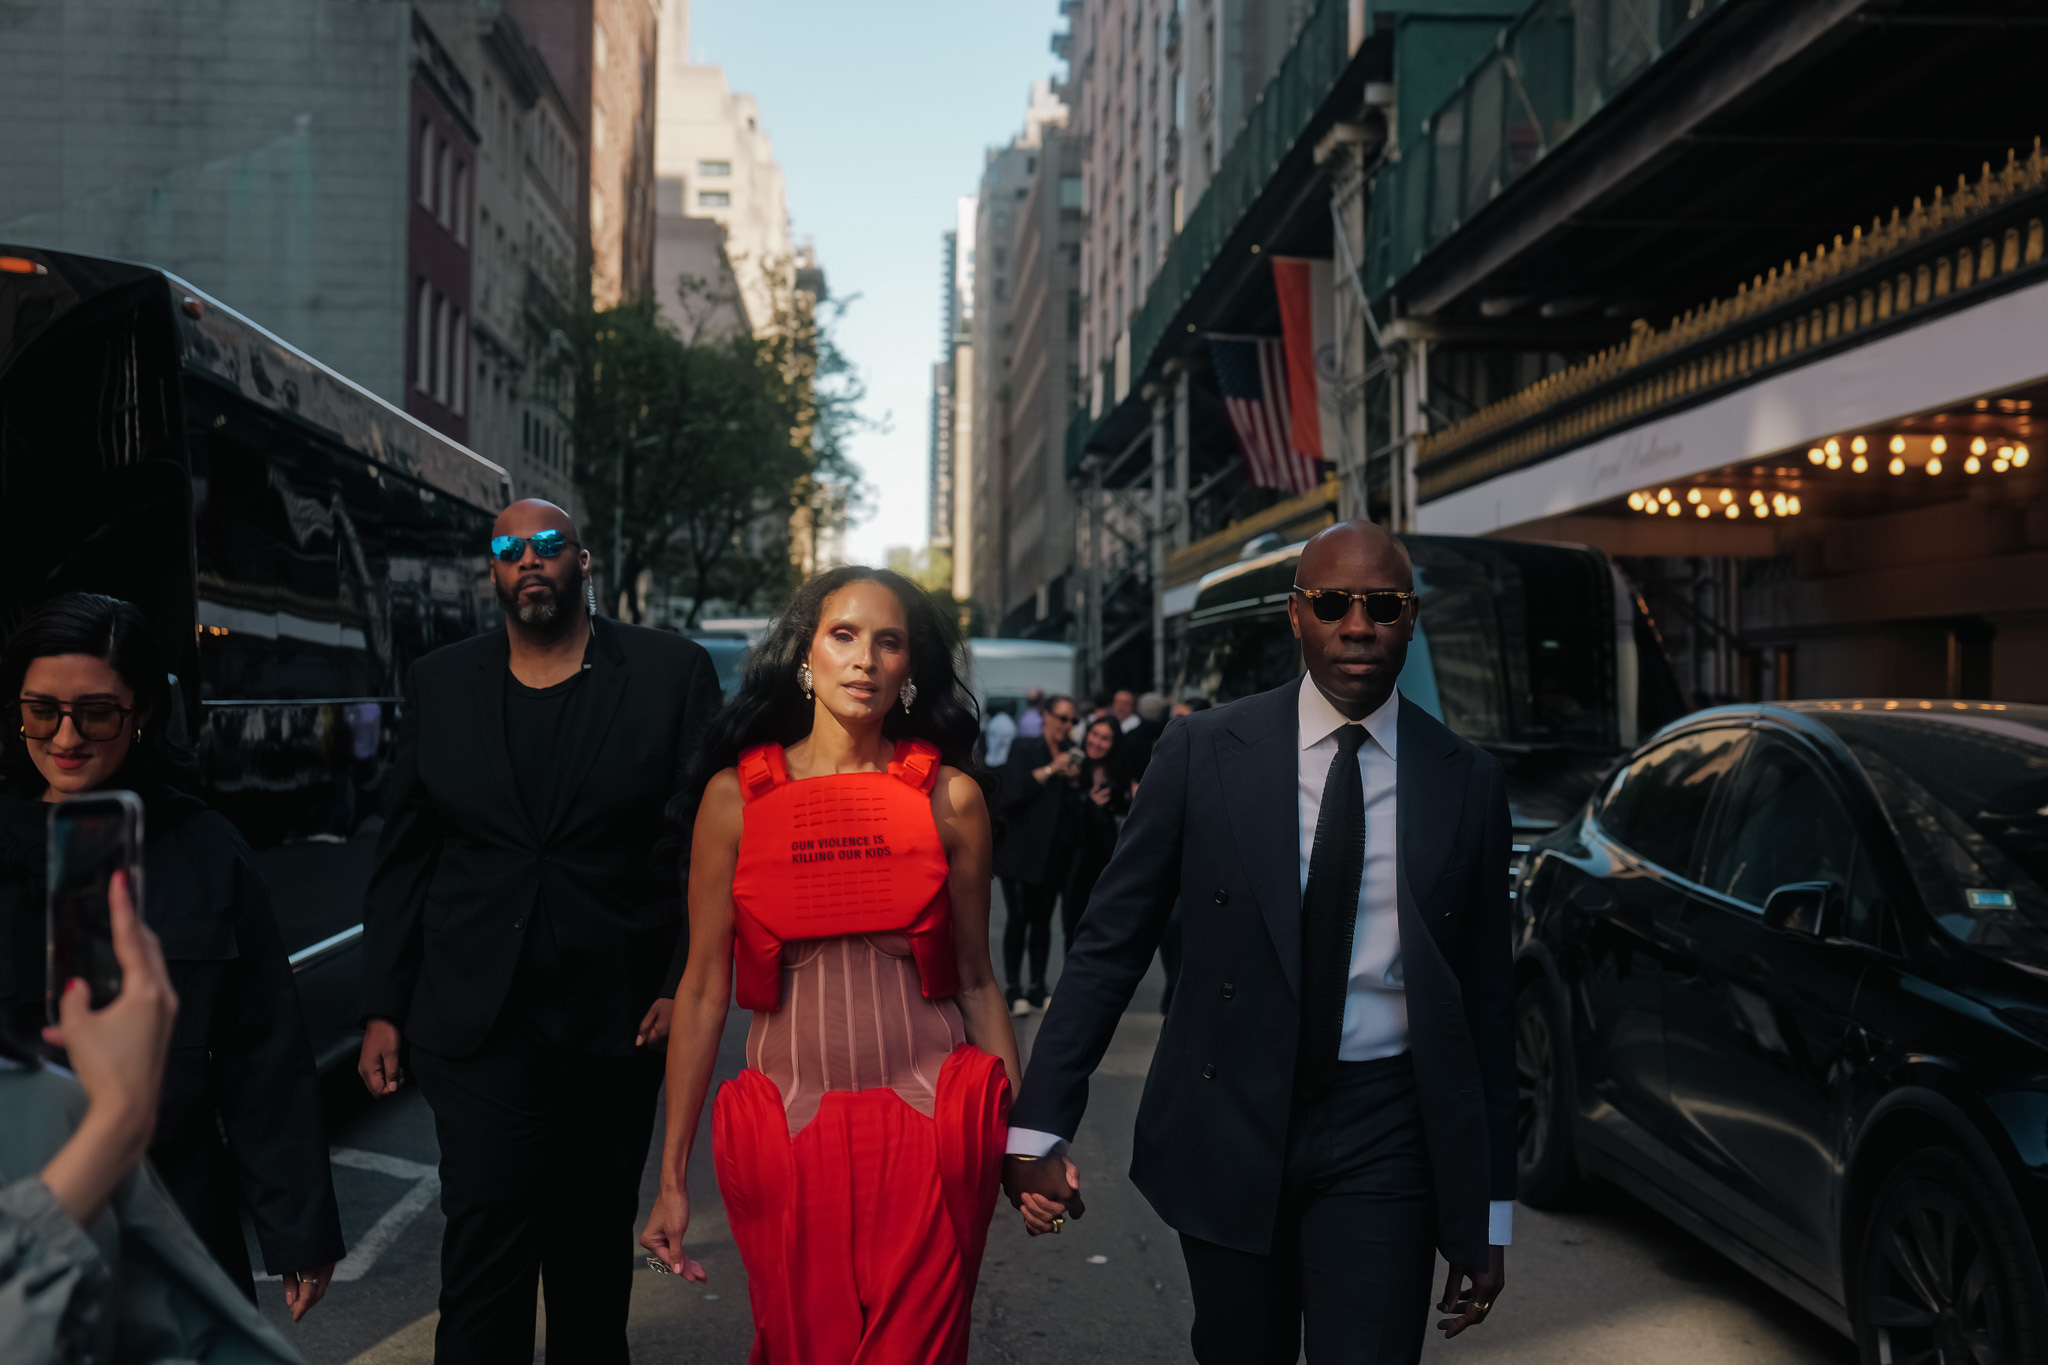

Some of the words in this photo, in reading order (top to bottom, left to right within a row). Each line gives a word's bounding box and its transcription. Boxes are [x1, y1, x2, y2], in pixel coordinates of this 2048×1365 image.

[792, 840, 814, 851] GUN
[818, 836, 870, 848] VIOLENCE
[873, 834, 884, 845] IS
[792, 851, 834, 864] KILLING
[838, 850, 862, 860] OUR
[865, 846, 891, 858] KIDS
